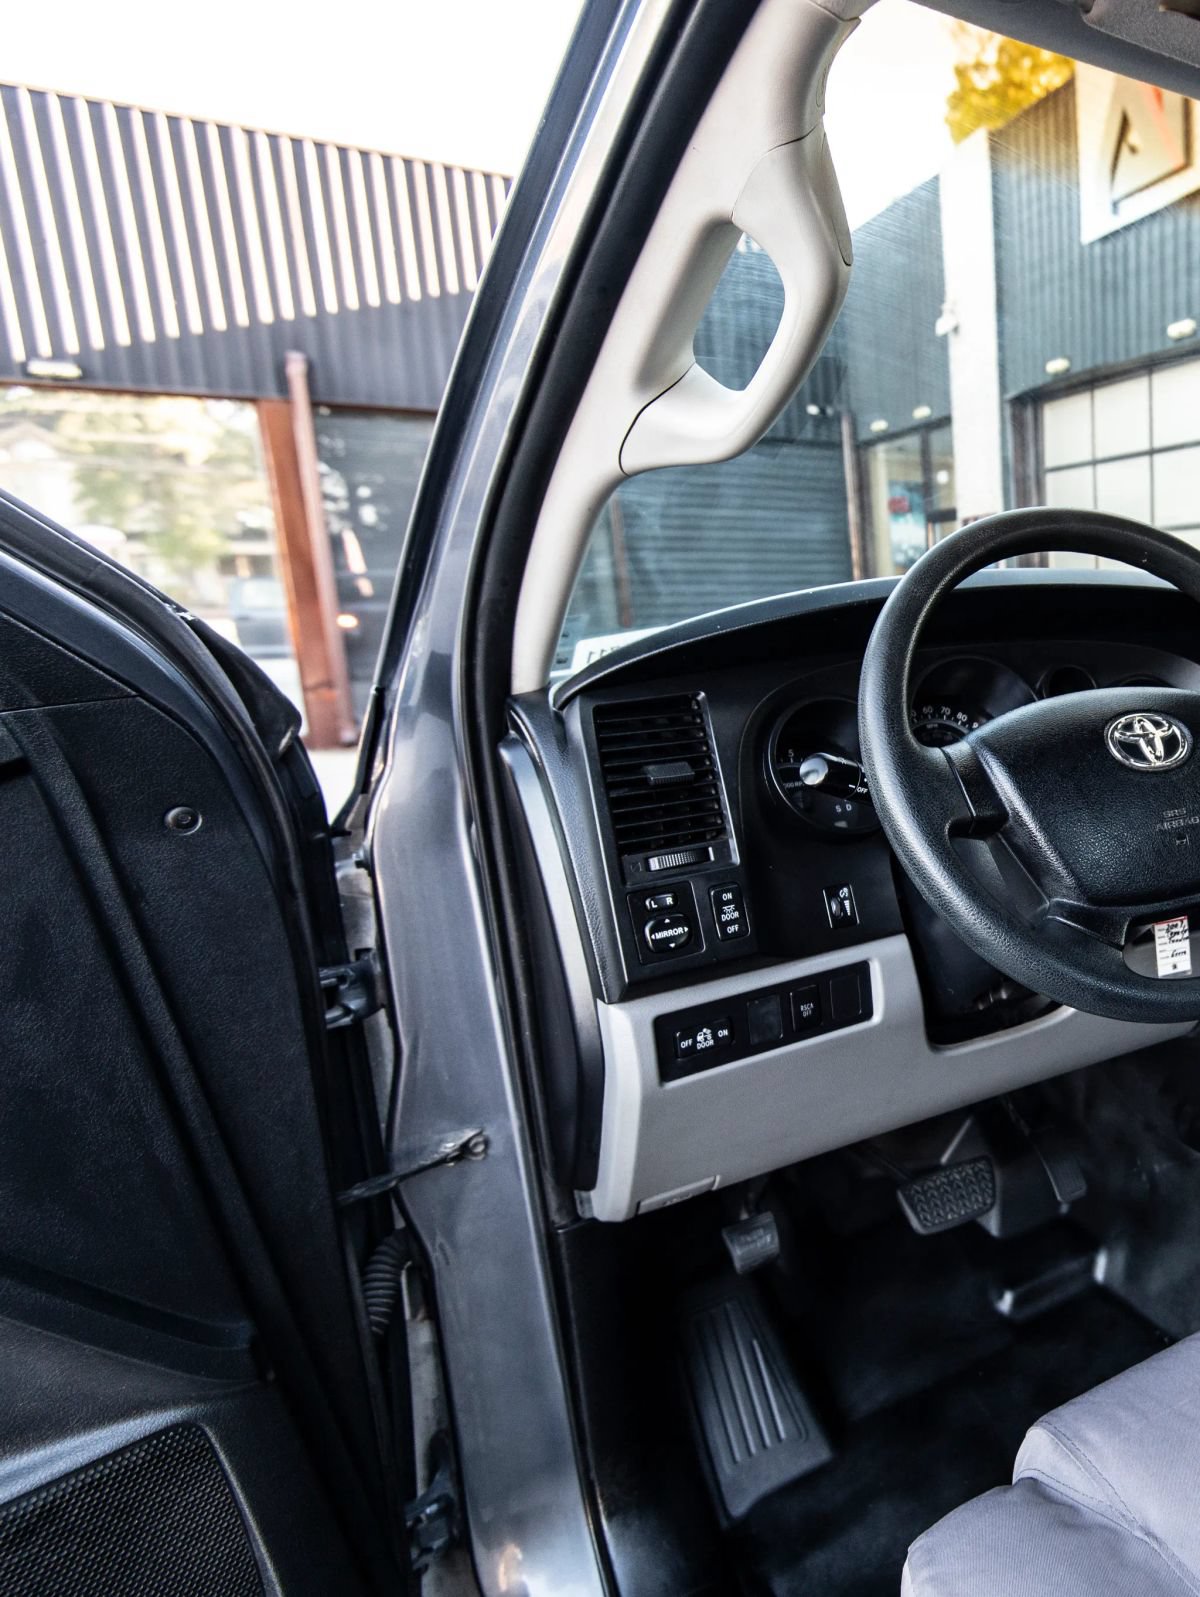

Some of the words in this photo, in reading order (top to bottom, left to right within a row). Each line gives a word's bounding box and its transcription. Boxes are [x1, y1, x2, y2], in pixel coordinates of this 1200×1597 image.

[940, 705, 951, 715] 70
[956, 711, 968, 722] 80
[1163, 808, 1186, 818] SRS
[1156, 816, 1200, 831] AIRBAG
[722, 892, 733, 901] ON
[651, 900, 658, 908] L
[666, 897, 673, 905] R
[721, 911, 739, 921] DOOR
[655, 927, 684, 939] MIRROR
[727, 924, 739, 934] OFF
[800, 1002, 814, 1011] RSCA
[680, 1038, 693, 1048] OFF
[697, 1039, 714, 1050] DOOR
[717, 1028, 729, 1038] ON
